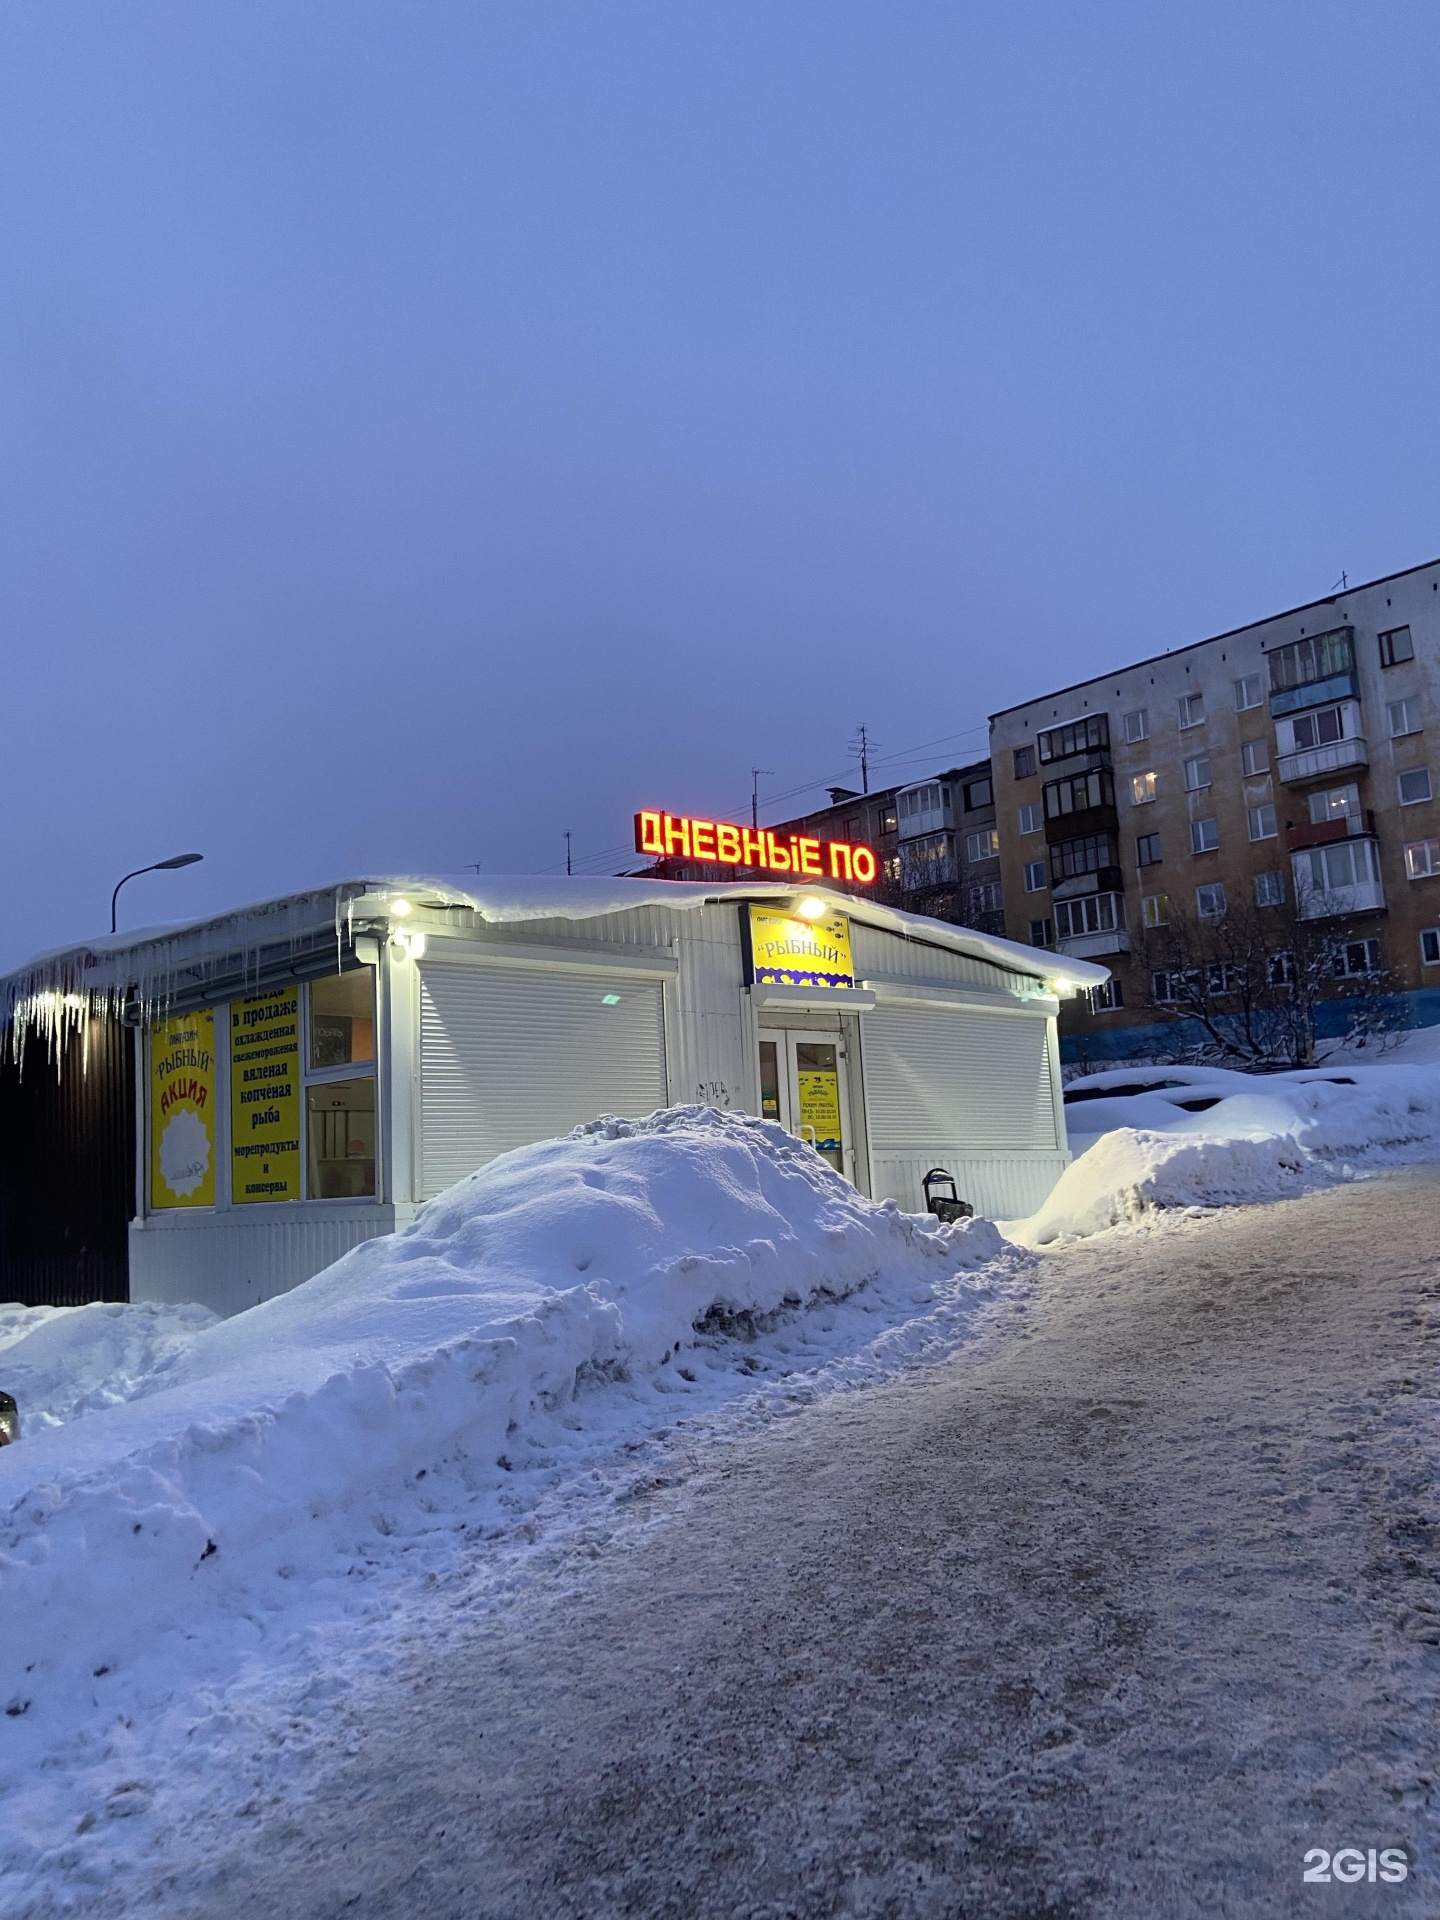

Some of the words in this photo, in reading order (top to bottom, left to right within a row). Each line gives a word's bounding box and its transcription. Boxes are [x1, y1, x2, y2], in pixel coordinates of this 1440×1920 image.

[829, 841, 876, 883] ПО
[232, 1013, 240, 1027] в
[243, 999, 298, 1027] продаже
[234, 1024, 296, 1046] охлажденная
[233, 1042, 298, 1063] свежемороженая
[243, 1062, 288, 1083] вяленая
[160, 1077, 208, 1116] АКЦИЯ
[240, 1083, 292, 1104] копчёная
[251, 1105, 280, 1130] рыба
[234, 1139, 299, 1159] морепродукты
[263, 1163, 269, 1174] и
[245, 1181, 288, 1195] консервы
